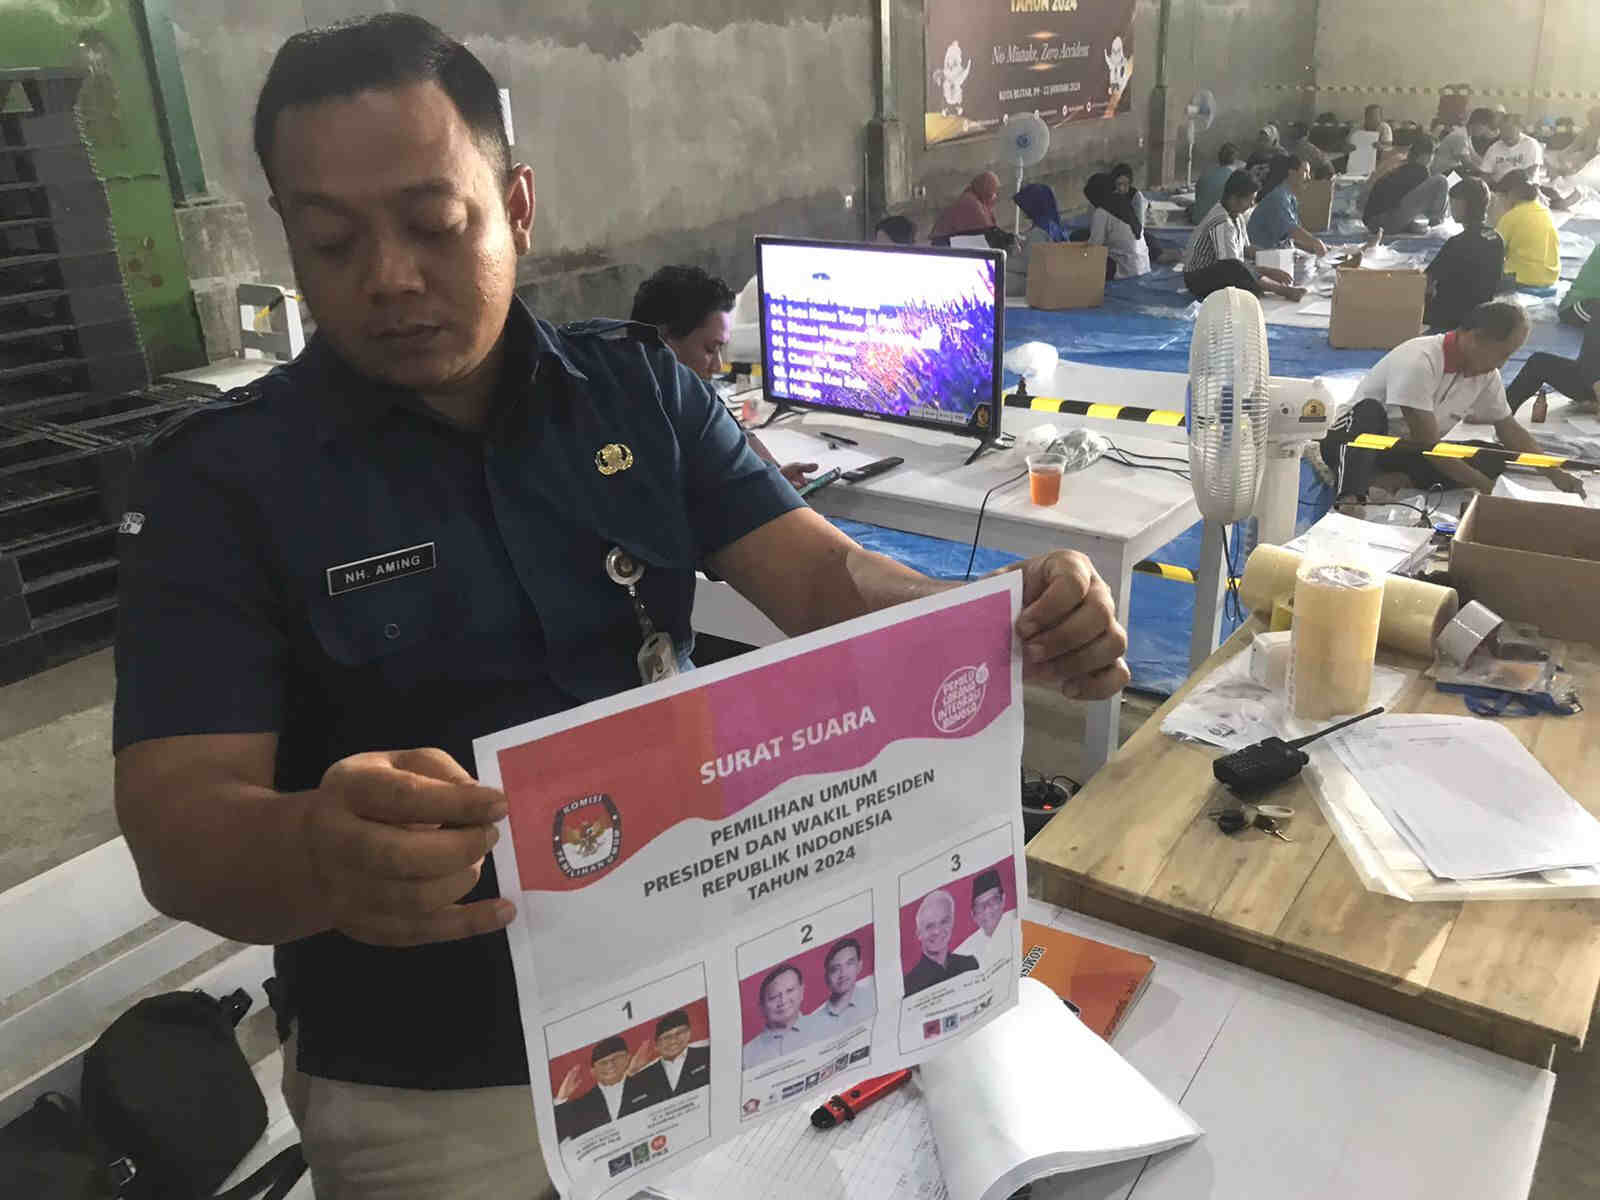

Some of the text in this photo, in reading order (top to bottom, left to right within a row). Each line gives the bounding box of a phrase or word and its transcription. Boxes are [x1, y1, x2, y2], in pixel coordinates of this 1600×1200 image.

[1010, 0, 1077, 12] TAHUN 2024
[345, 555, 421, 584] NH. AMING
[699, 705, 876, 785] SURAT SUARA
[711, 769, 878, 847] PEMILIHAN UMUM
[643, 768, 935, 897] PRESIDEN DAN WAKIL PRESIDEN
[702, 809, 892, 898] REPUBLIK INDONESIA
[747, 845, 856, 900] TAHUN 2024
[950, 854, 961, 872] 3
[800, 924, 813, 944] 2
[621, 1001, 633, 1020] 1
